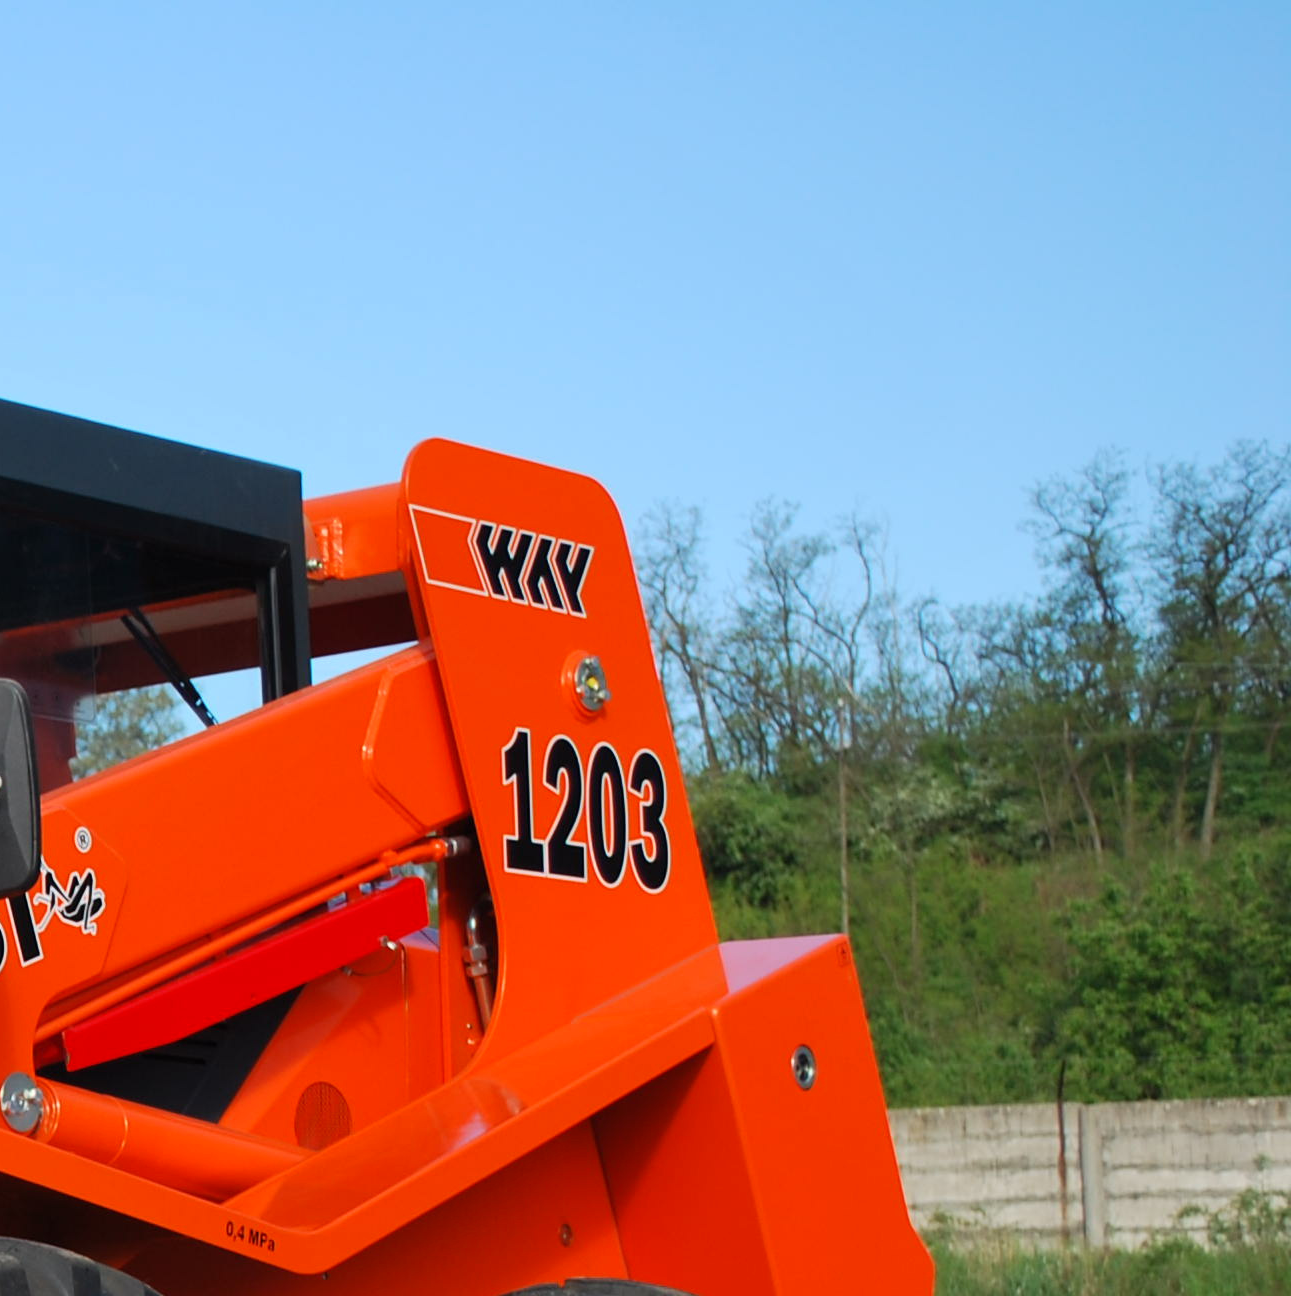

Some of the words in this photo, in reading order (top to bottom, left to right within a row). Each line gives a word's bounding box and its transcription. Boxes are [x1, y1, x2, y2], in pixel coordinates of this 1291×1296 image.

[473, 519, 595, 619] WAY
[501, 726, 671, 895] 1203
[225, 1220, 245, 1241] 0,4
[248, 1228, 276, 1252] MPa
